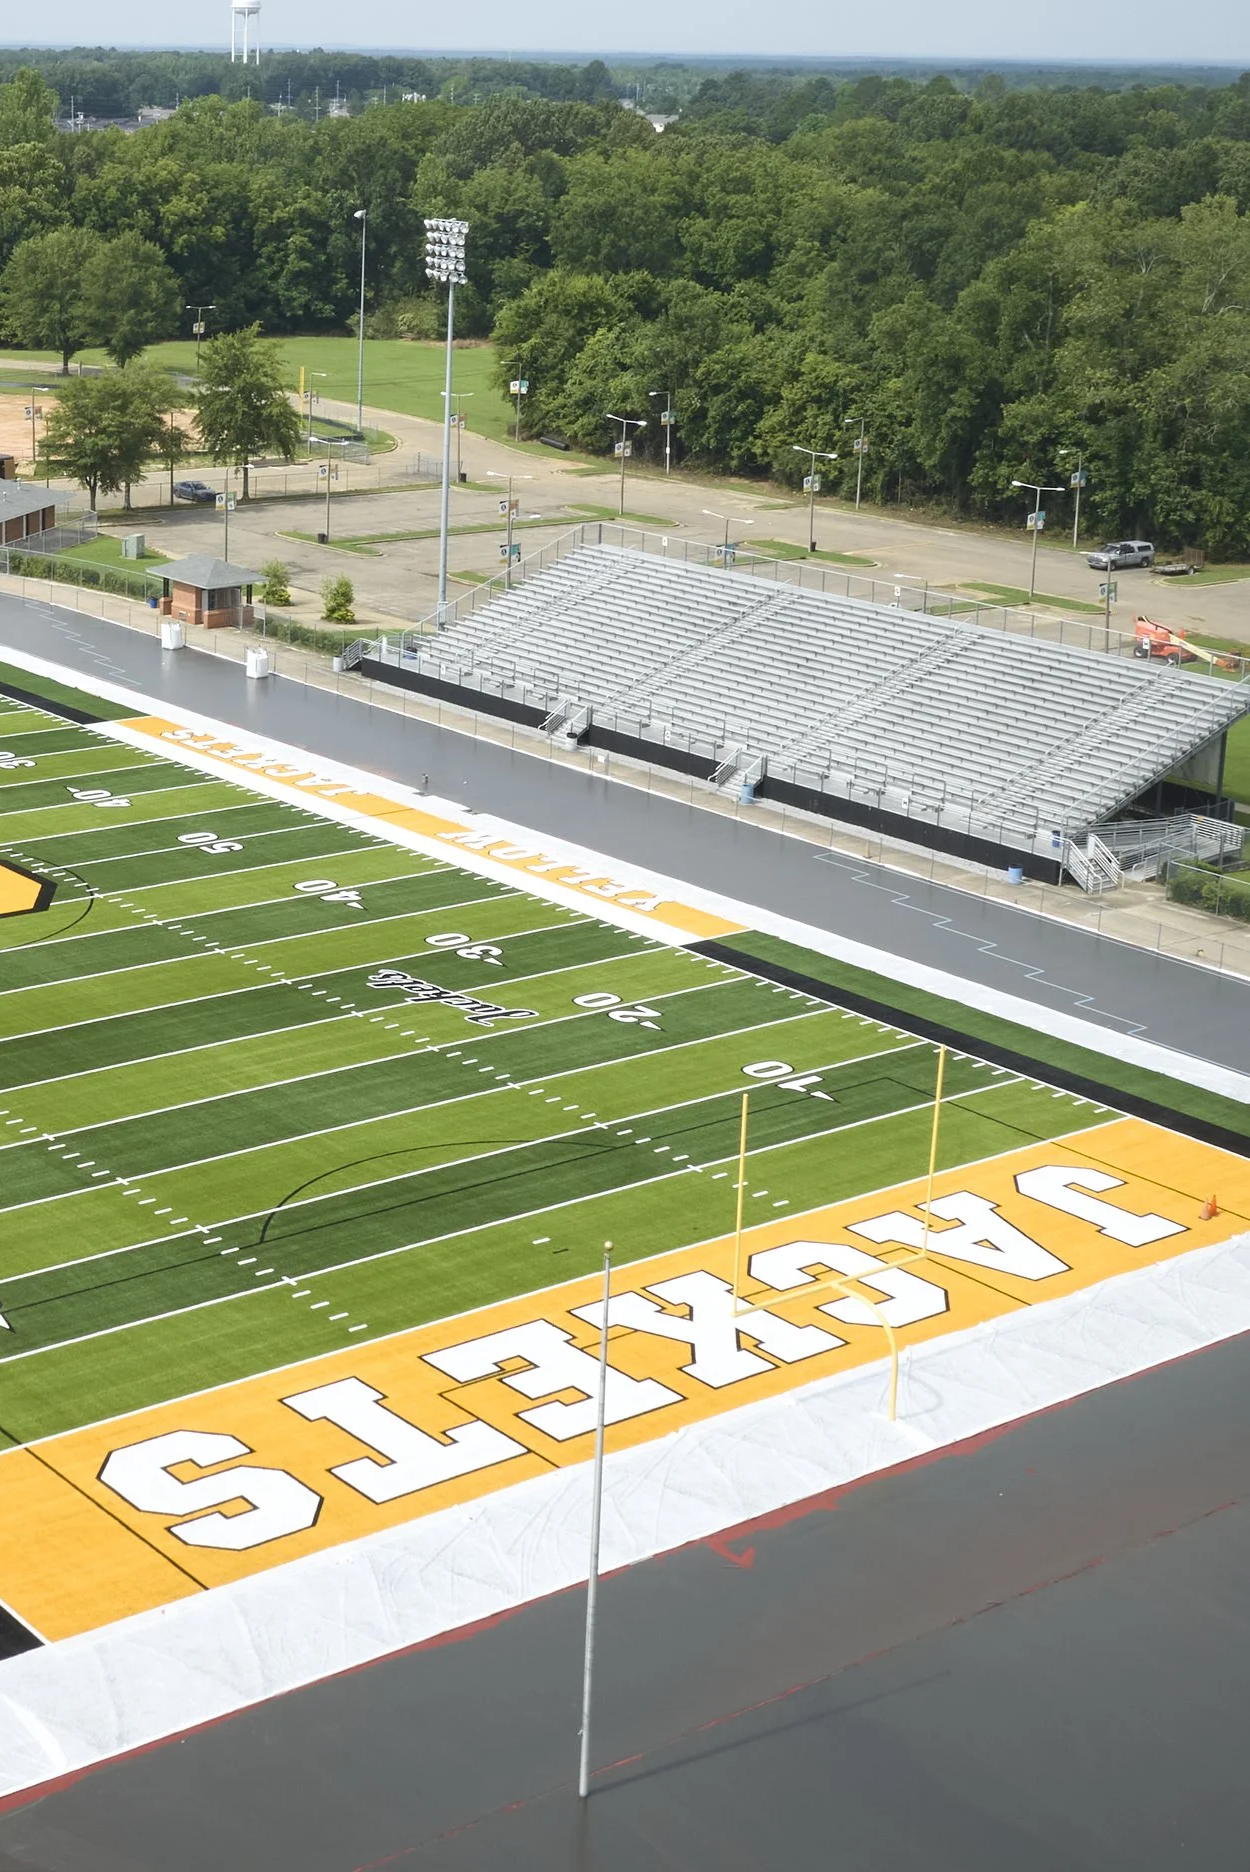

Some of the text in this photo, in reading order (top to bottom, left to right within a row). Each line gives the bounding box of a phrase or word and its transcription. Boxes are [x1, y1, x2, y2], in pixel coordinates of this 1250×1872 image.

[71, 789, 131, 808] 40
[177, 832, 243, 854] 50
[294, 880, 359, 902] 40
[424, 933, 502, 961] 30
[573, 992, 661, 1023] 20
[742, 1061, 823, 1092] 10
[96, 1163, 1192, 1551] JACKETS
